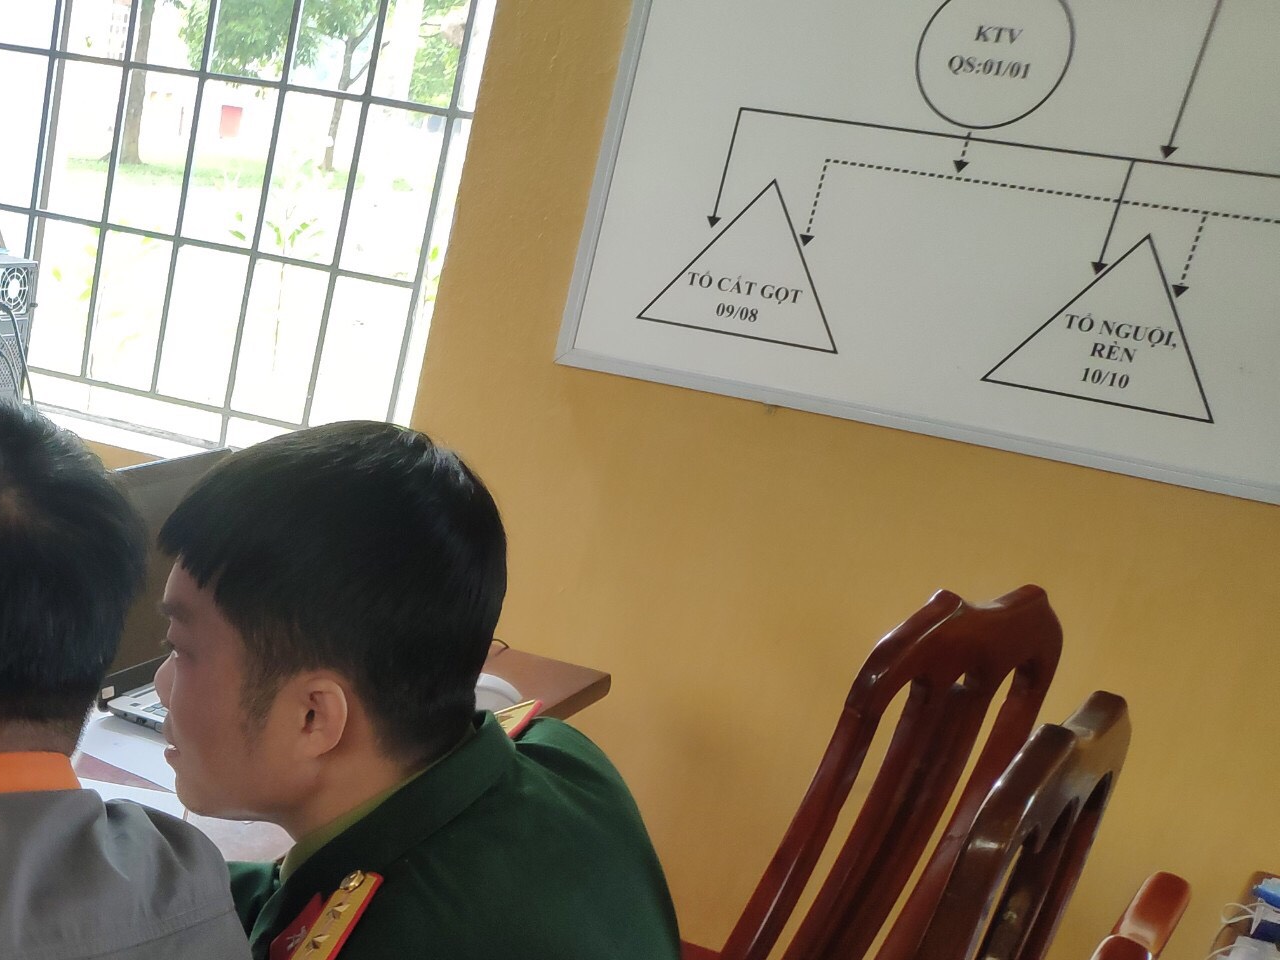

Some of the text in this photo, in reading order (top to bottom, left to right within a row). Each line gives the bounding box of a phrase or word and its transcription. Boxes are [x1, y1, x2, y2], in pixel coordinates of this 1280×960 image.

[974, 25, 1024, 45] KTV
[947, 54, 1031, 79] QS:01/01
[760, 284, 803, 305] GỌT
[715, 302, 759, 323] 09/08
[1065, 312, 1094, 333] TỔ
[1090, 340, 1137, 363] RÈN
[1081, 367, 1130, 389] 10/10
